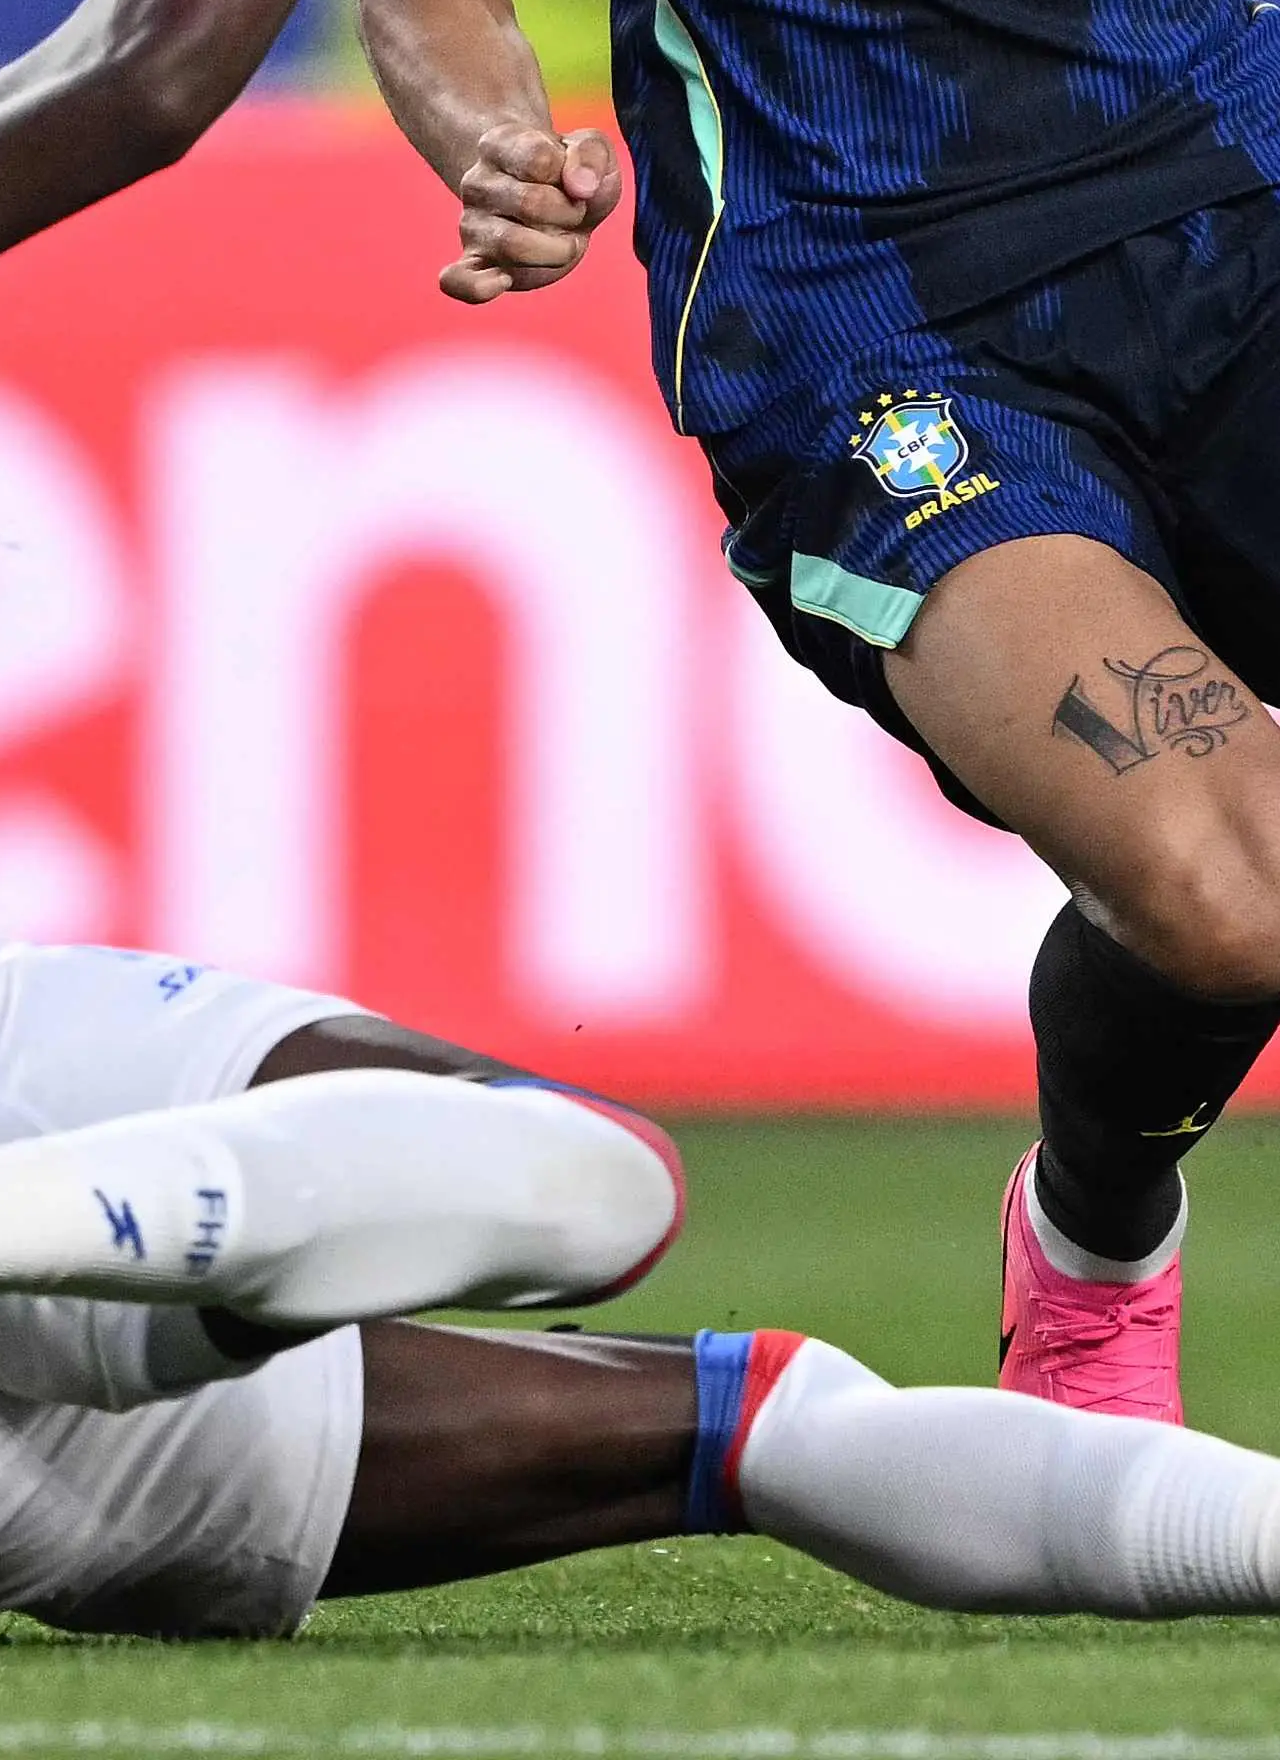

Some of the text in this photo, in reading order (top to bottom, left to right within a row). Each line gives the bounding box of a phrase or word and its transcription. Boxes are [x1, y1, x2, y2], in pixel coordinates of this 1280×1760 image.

[897, 434, 929, 459] CBF
[904, 472, 1001, 530] BRASIL
[1051, 645, 1252, 776] Viver
